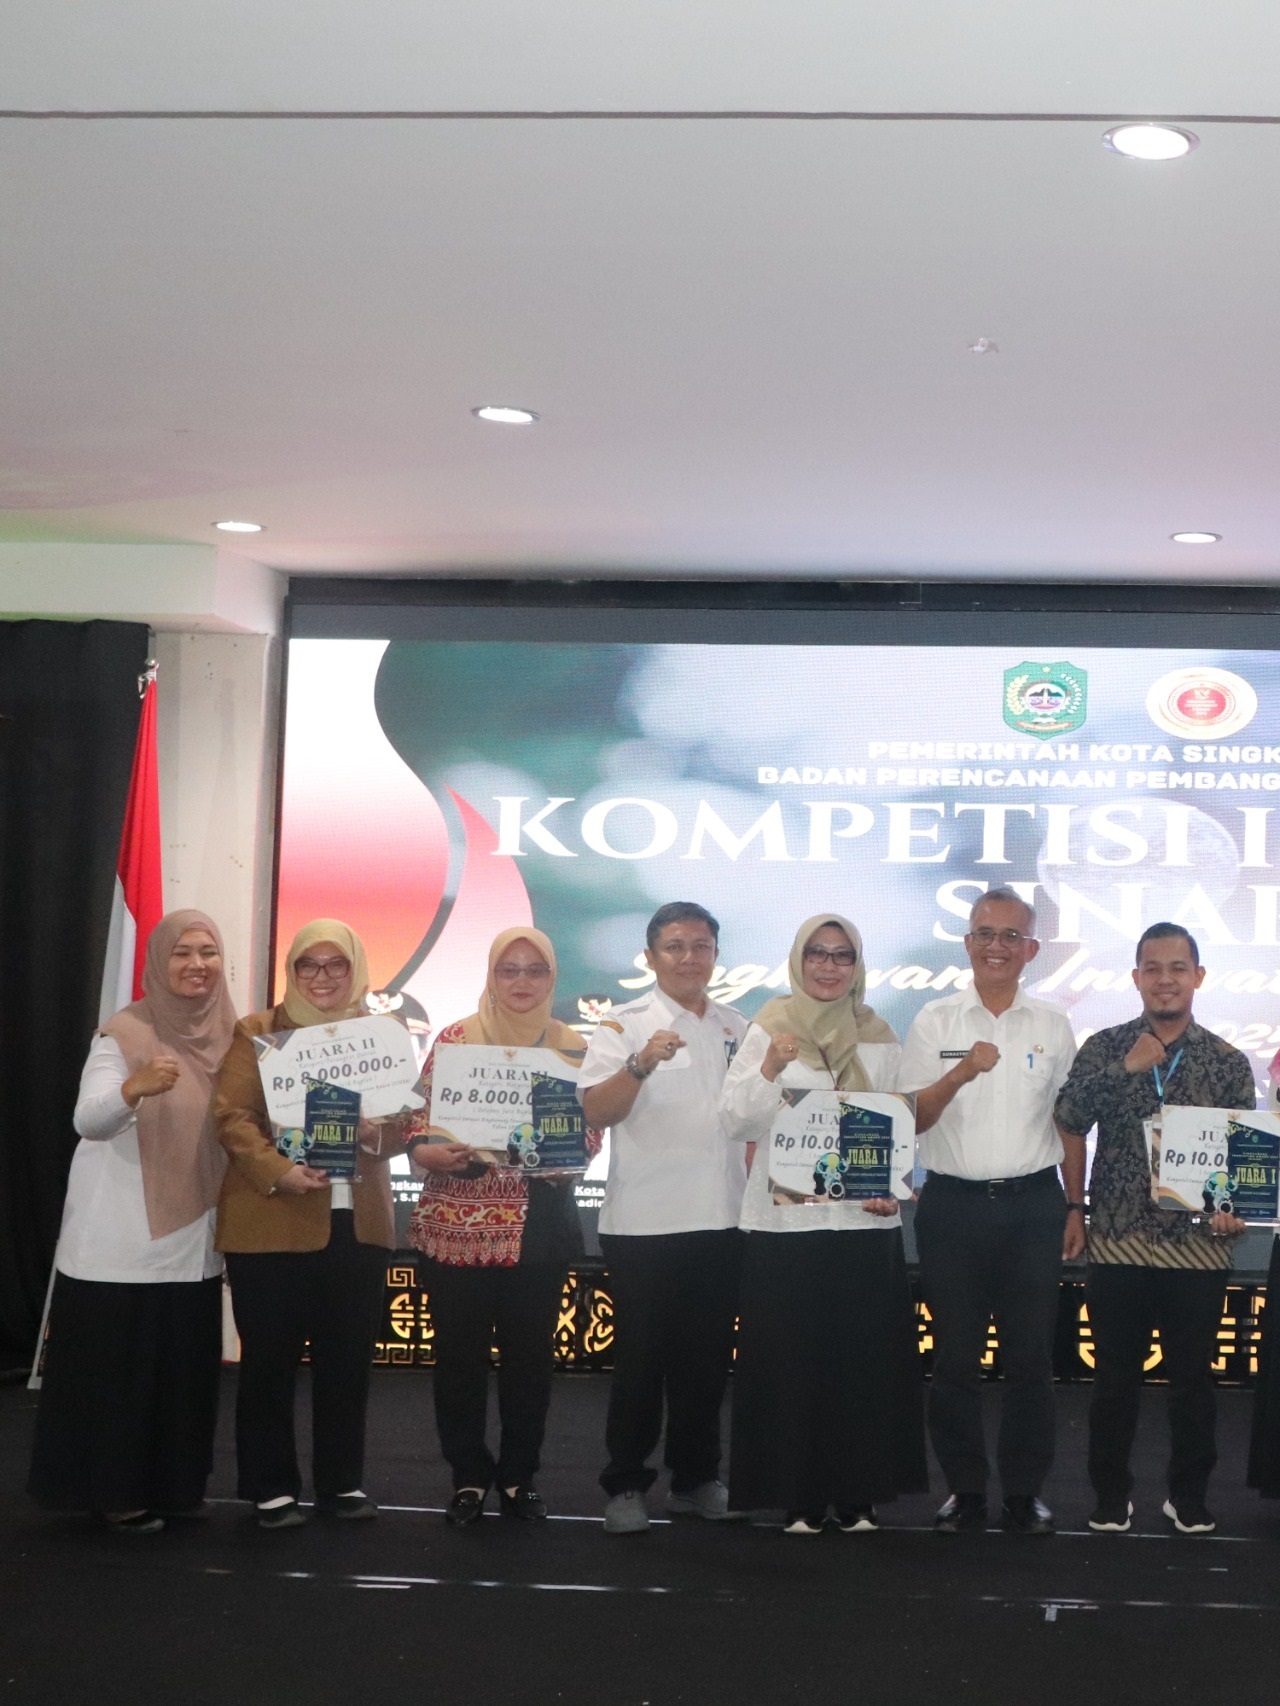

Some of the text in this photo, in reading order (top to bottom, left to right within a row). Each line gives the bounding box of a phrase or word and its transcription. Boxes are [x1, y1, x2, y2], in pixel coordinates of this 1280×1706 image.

[868, 741, 1080, 762] PEMERINTAH
[1090, 743, 1174, 764] KOTA
[757, 766, 866, 786] BADAN
[877, 768, 1116, 788] PERENCANAAN
[490, 796, 1199, 867] KOMPETISI
[295, 1040, 357, 1062] JUARA
[362, 1037, 376, 1049] II
[272, 1056, 407, 1092] Rp 8000.000.-
[469, 1067, 529, 1081] JUARA
[440, 1087, 533, 1106] Rp 8.000.0
[539, 1117, 581, 1133] JUARA II
[808, 1113, 840, 1125] JUA
[312, 1124, 354, 1142] JUARA II
[774, 1133, 796, 1151] Rp
[1198, 1130, 1228, 1142] JUA
[846, 1148, 878, 1165] JUARA
[1165, 1149, 1186, 1167] Rp
[1235, 1167, 1267, 1184] JUARA
